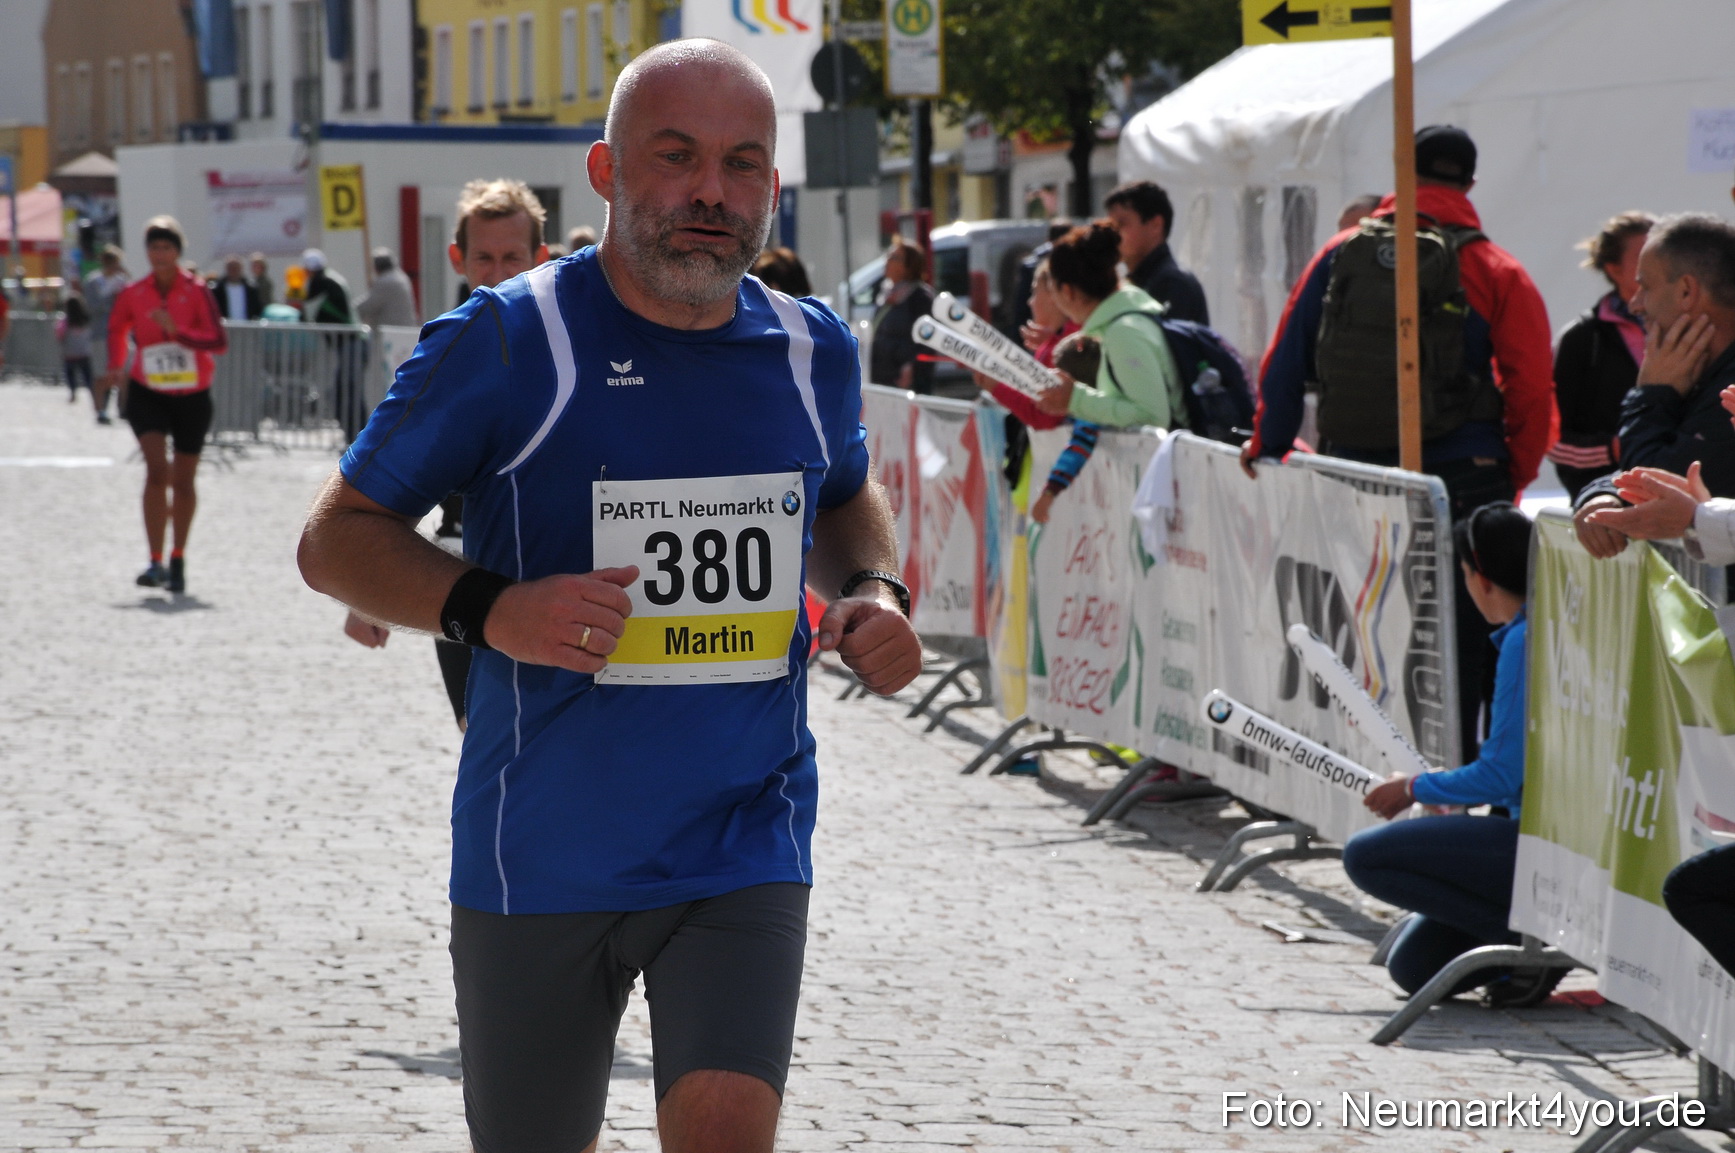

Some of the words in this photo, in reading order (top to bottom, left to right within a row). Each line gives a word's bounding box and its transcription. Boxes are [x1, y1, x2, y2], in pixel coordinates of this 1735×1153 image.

[331, 185, 356, 216] D
[607, 376, 645, 386] erima
[600, 501, 674, 520] PARTL
[679, 497, 774, 518] Neumarkt
[643, 527, 772, 606] 380
[665, 625, 754, 655] Martin
[1242, 715, 1372, 796] bmw-laufsport
